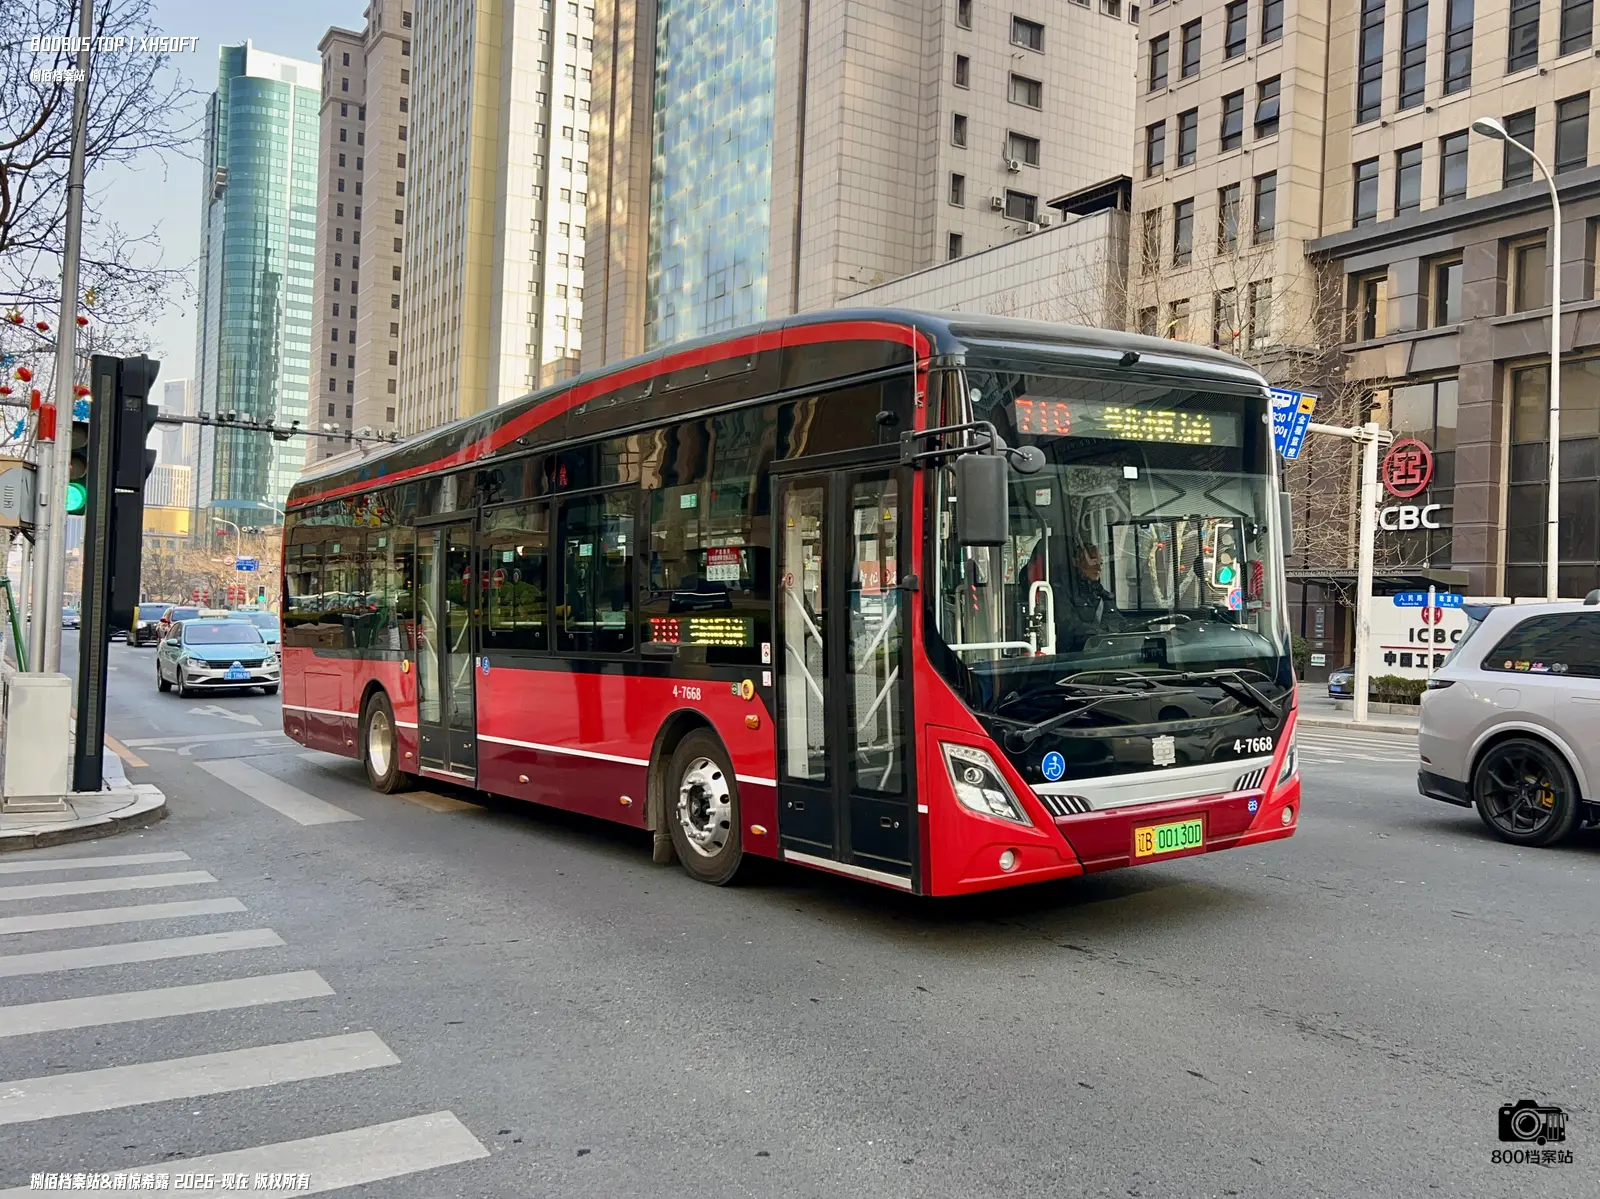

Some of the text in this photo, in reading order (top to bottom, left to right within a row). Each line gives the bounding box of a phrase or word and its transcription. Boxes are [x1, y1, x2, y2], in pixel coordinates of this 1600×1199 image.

[1015, 399, 1071, 434] 710
[1286, 415, 1306, 457] 全程监控
[1379, 503, 1441, 531] CBC
[1398, 594, 1423, 602] 人民路
[1409, 628, 1462, 644] ICBC
[672, 685, 701, 700] 4-7668
[1233, 736, 1273, 754] 4-7668
